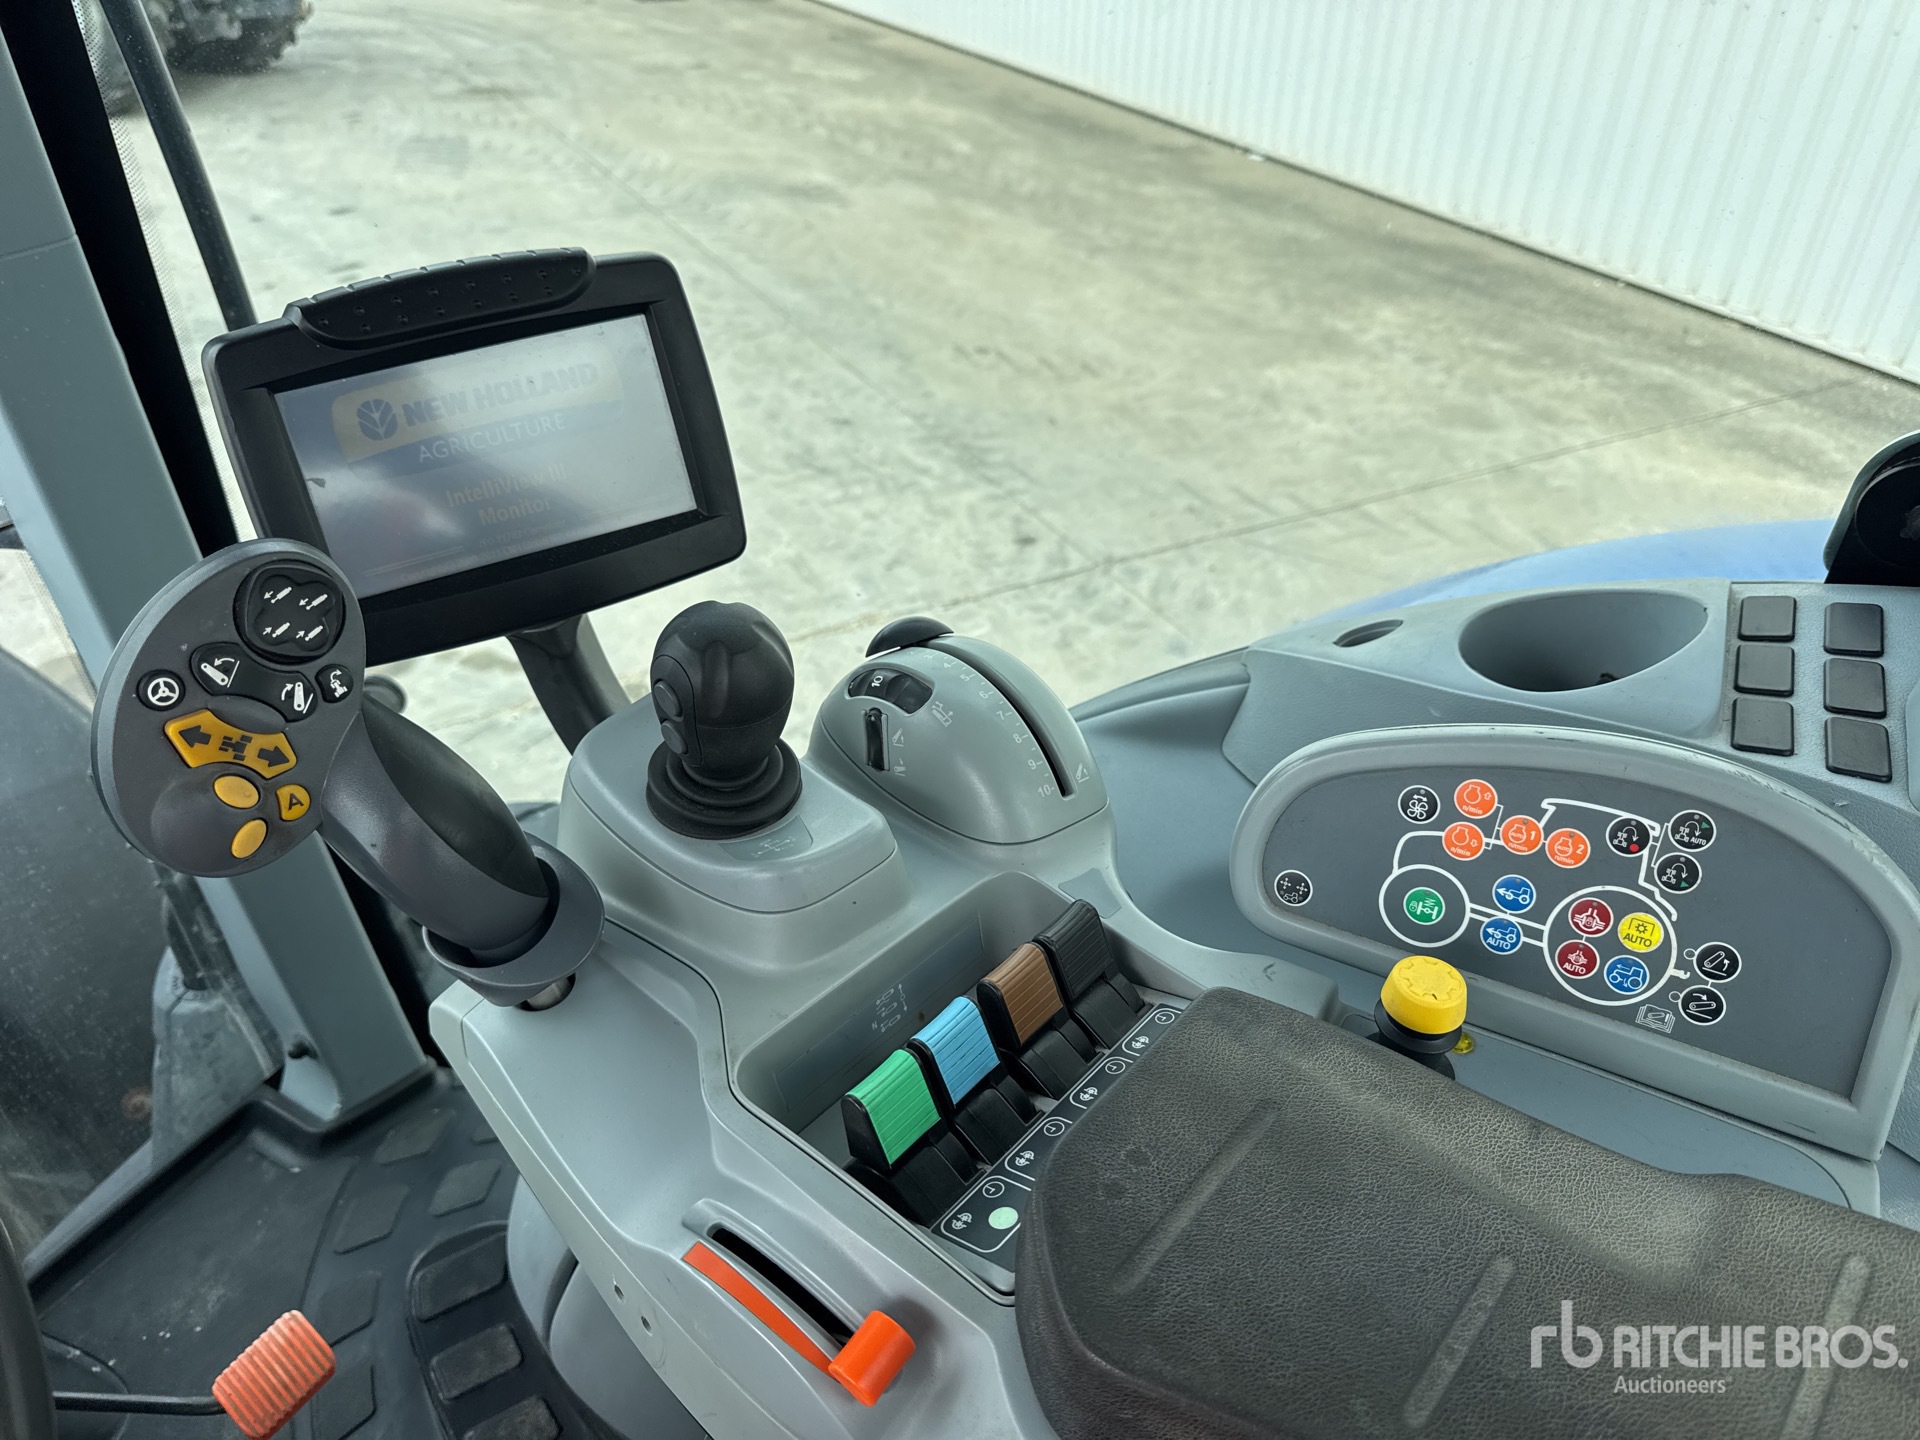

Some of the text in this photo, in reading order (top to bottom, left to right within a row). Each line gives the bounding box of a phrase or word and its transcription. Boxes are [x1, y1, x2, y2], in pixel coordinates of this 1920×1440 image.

[402, 362, 599, 427] NEW HOLLAND
[419, 413, 567, 463] AGRICULTURE
[445, 470, 544, 508] IntelliView
[477, 498, 551, 527] Monitor
[871, 675, 883, 688] 10
[960, 674, 970, 682] 5
[979, 690, 989, 699] 6
[995, 710, 1005, 720] 7
[1013, 733, 1023, 743] 8
[1028, 759, 1037, 770] 9
[1038, 784, 1052, 797] 10
[287, 792, 305, 811] A
[1462, 804, 1483, 815] n/min
[1510, 830, 1536, 841] AUTO 1
[1690, 836, 1707, 846] AUTO
[1450, 846, 1471, 857] n/min
[1575, 844, 1585, 855] 2
[1486, 937, 1511, 950] AUTO
[1622, 932, 1653, 948] AUTO
[1562, 962, 1587, 975] AUTO
